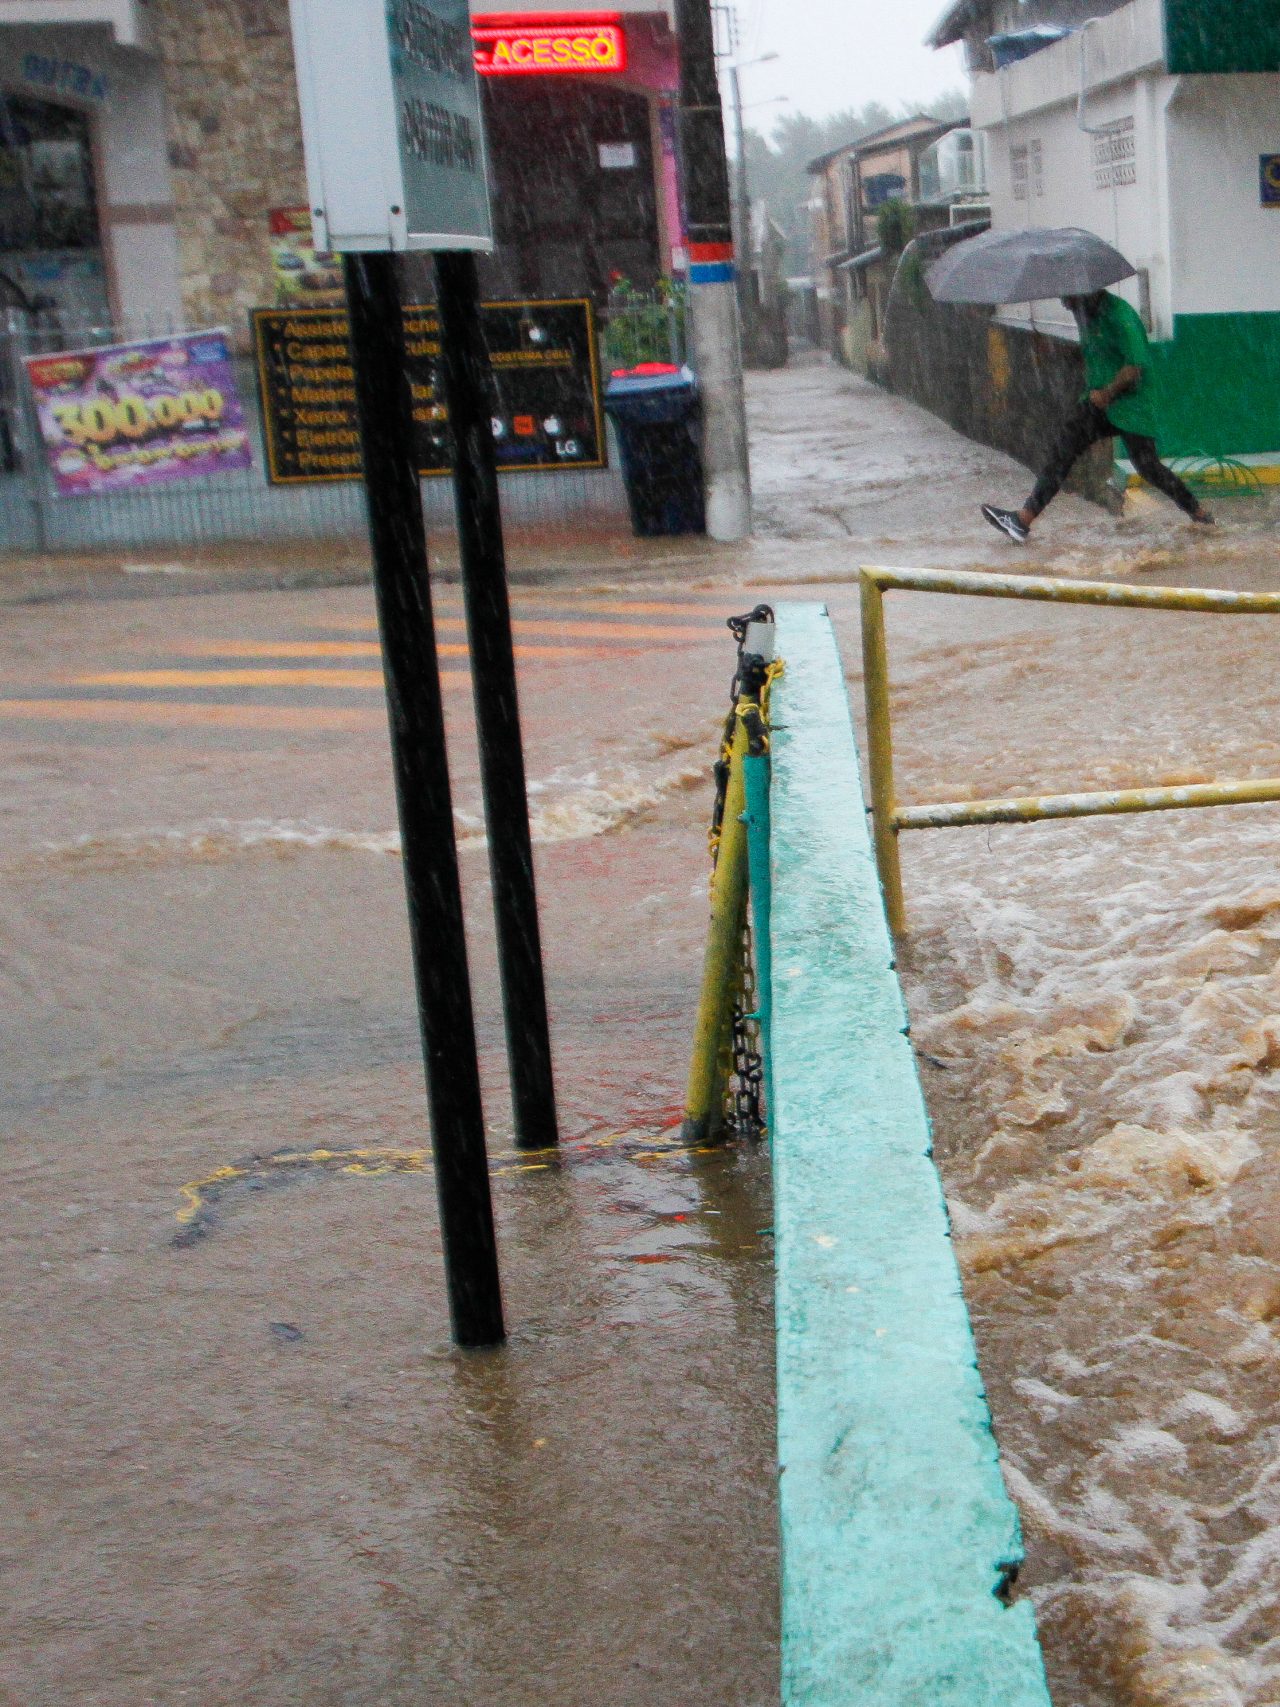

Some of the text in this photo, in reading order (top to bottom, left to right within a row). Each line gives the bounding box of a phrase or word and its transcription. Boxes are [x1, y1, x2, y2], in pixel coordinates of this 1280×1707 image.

[290, 363, 354, 382] Papela
[555, 439, 578, 457] LG
[299, 450, 362, 467] Presen
